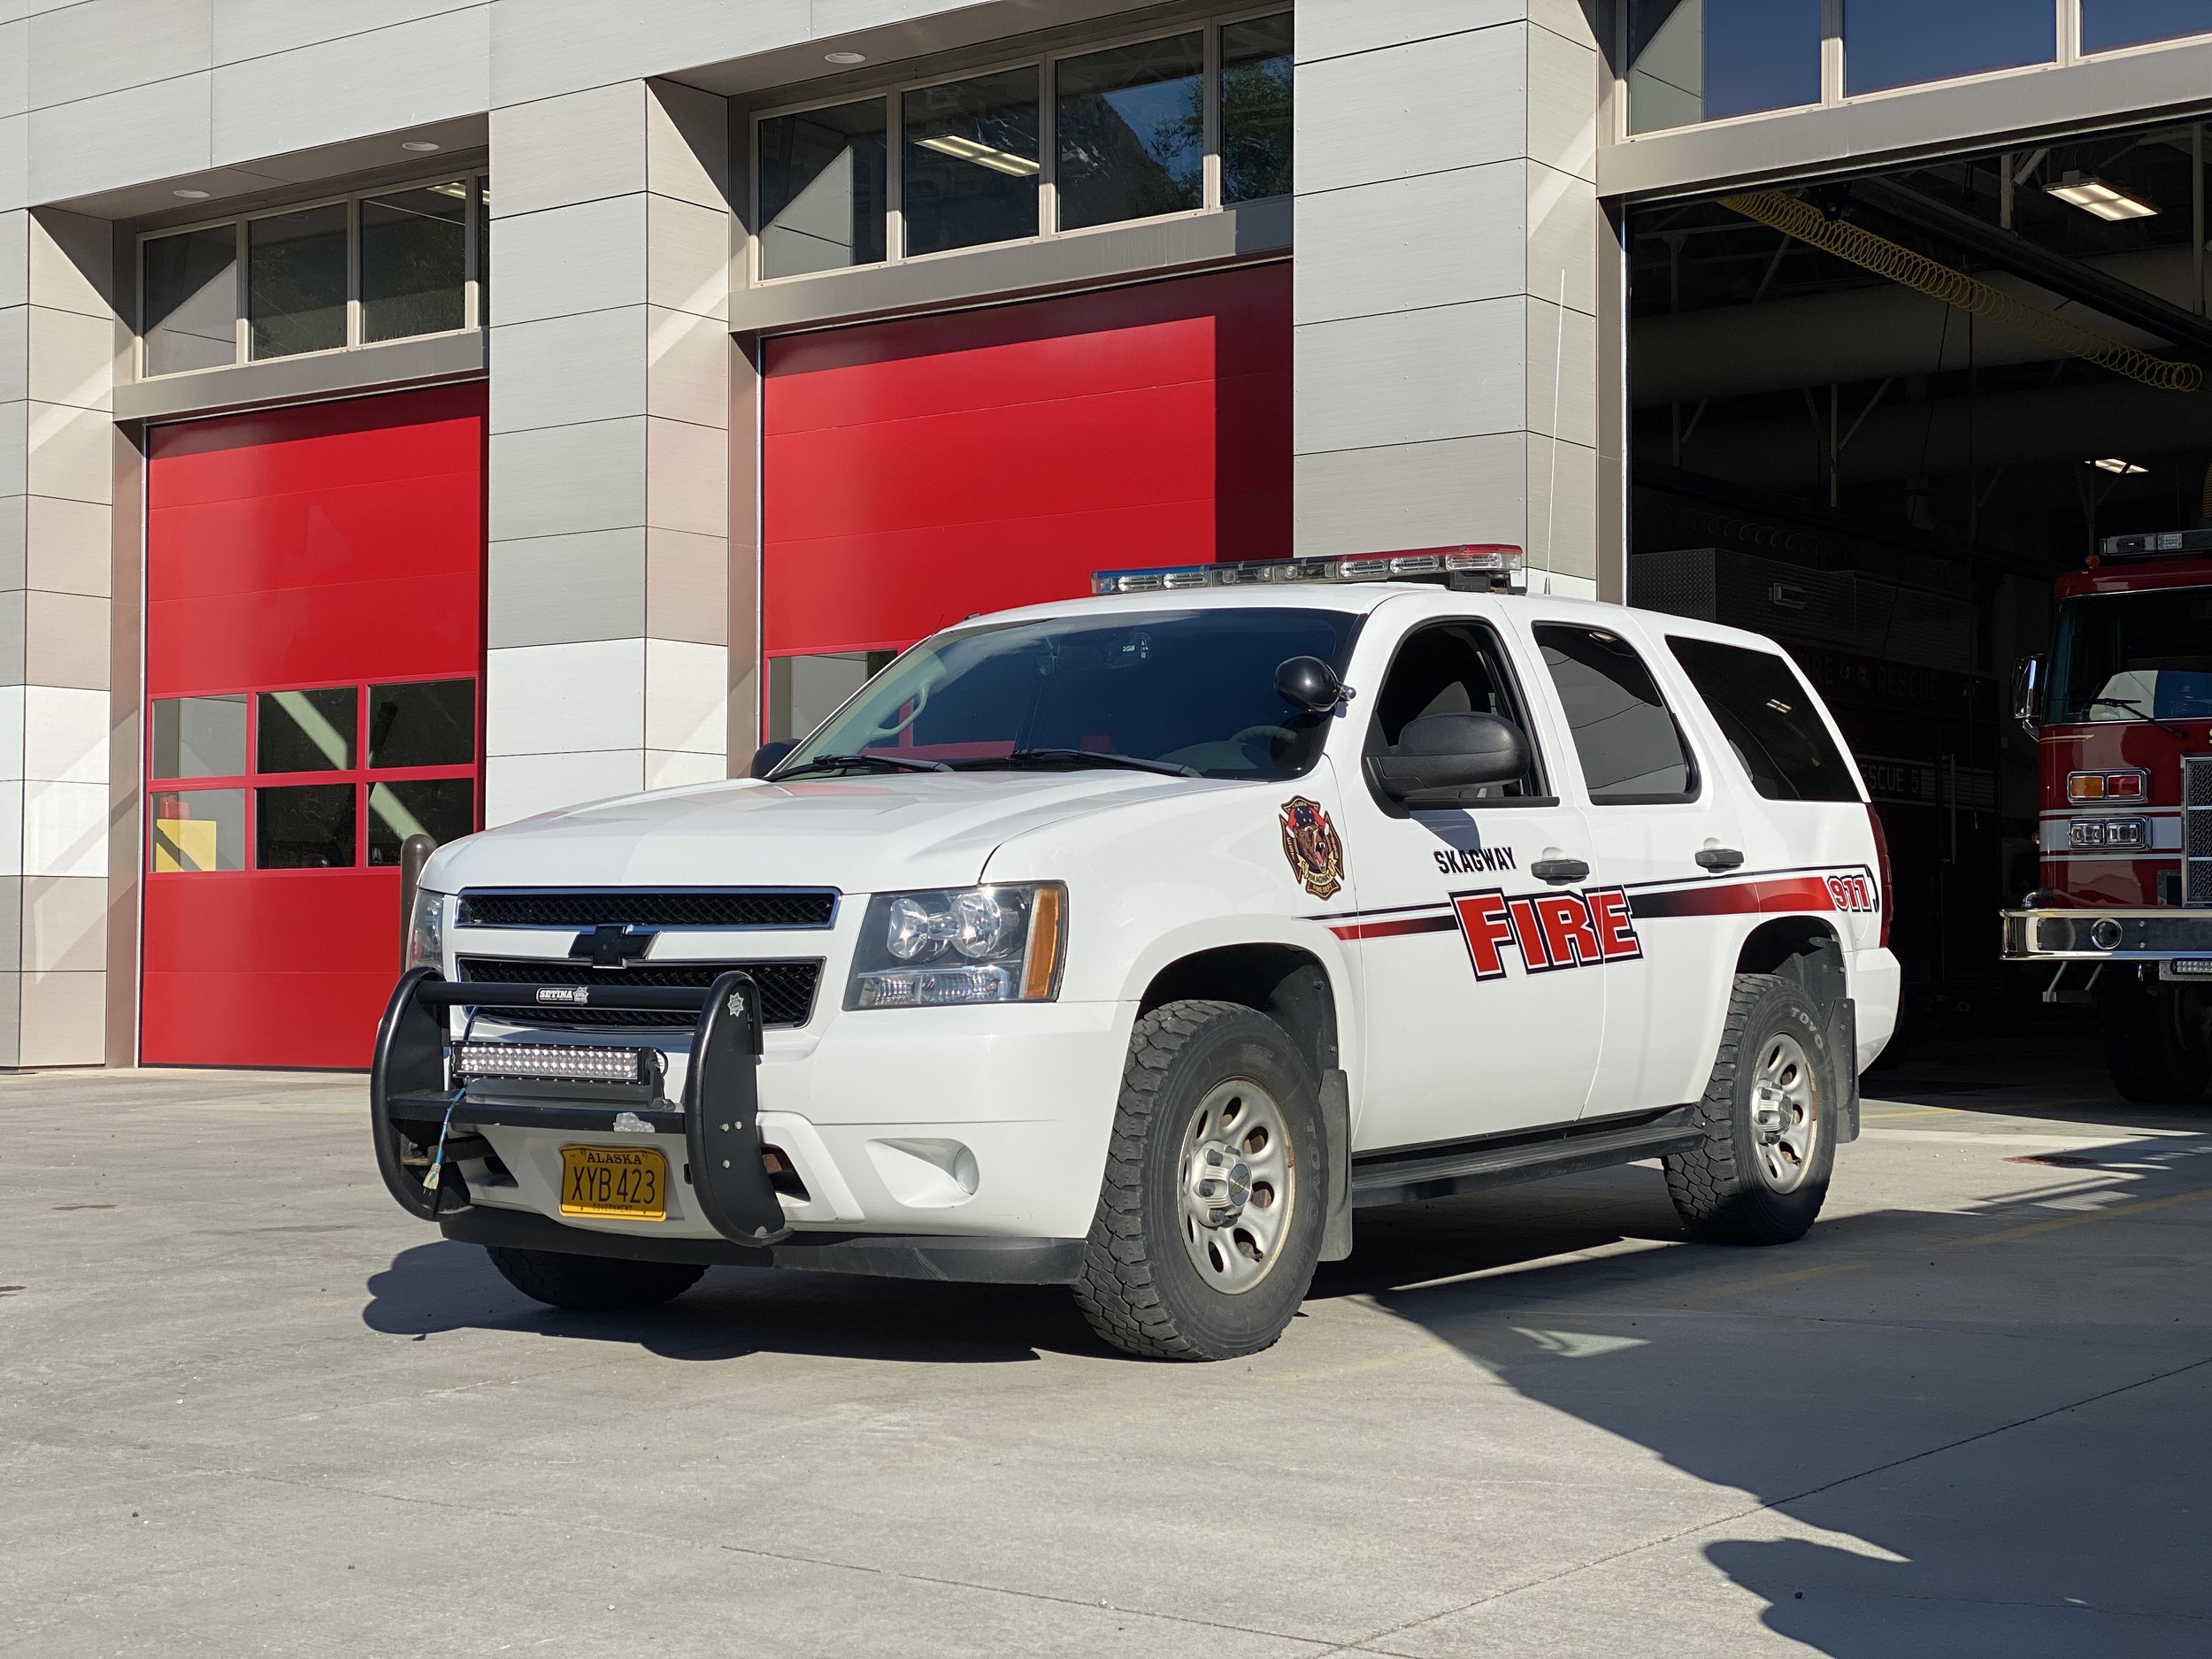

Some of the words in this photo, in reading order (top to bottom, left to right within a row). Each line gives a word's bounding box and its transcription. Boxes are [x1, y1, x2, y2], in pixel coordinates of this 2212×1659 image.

[1876, 665, 1939, 702] RESCUE
[1910, 768, 1919, 794] 5
[1433, 847, 1517, 874] SKAGWAY
[1827, 874, 1873, 912] 911
[1448, 884, 1644, 982] FIRE
[539, 989, 573, 999] SETINA
[1791, 1005, 1824, 1048] TOYO
[587, 1152, 642, 1165] ALASKA
[1304, 1116, 1321, 1228] TOYO
[572, 1166, 612, 1202] XYB
[616, 1168, 656, 1205] 423
[592, 1202, 633, 1214] GOVERNMENT
